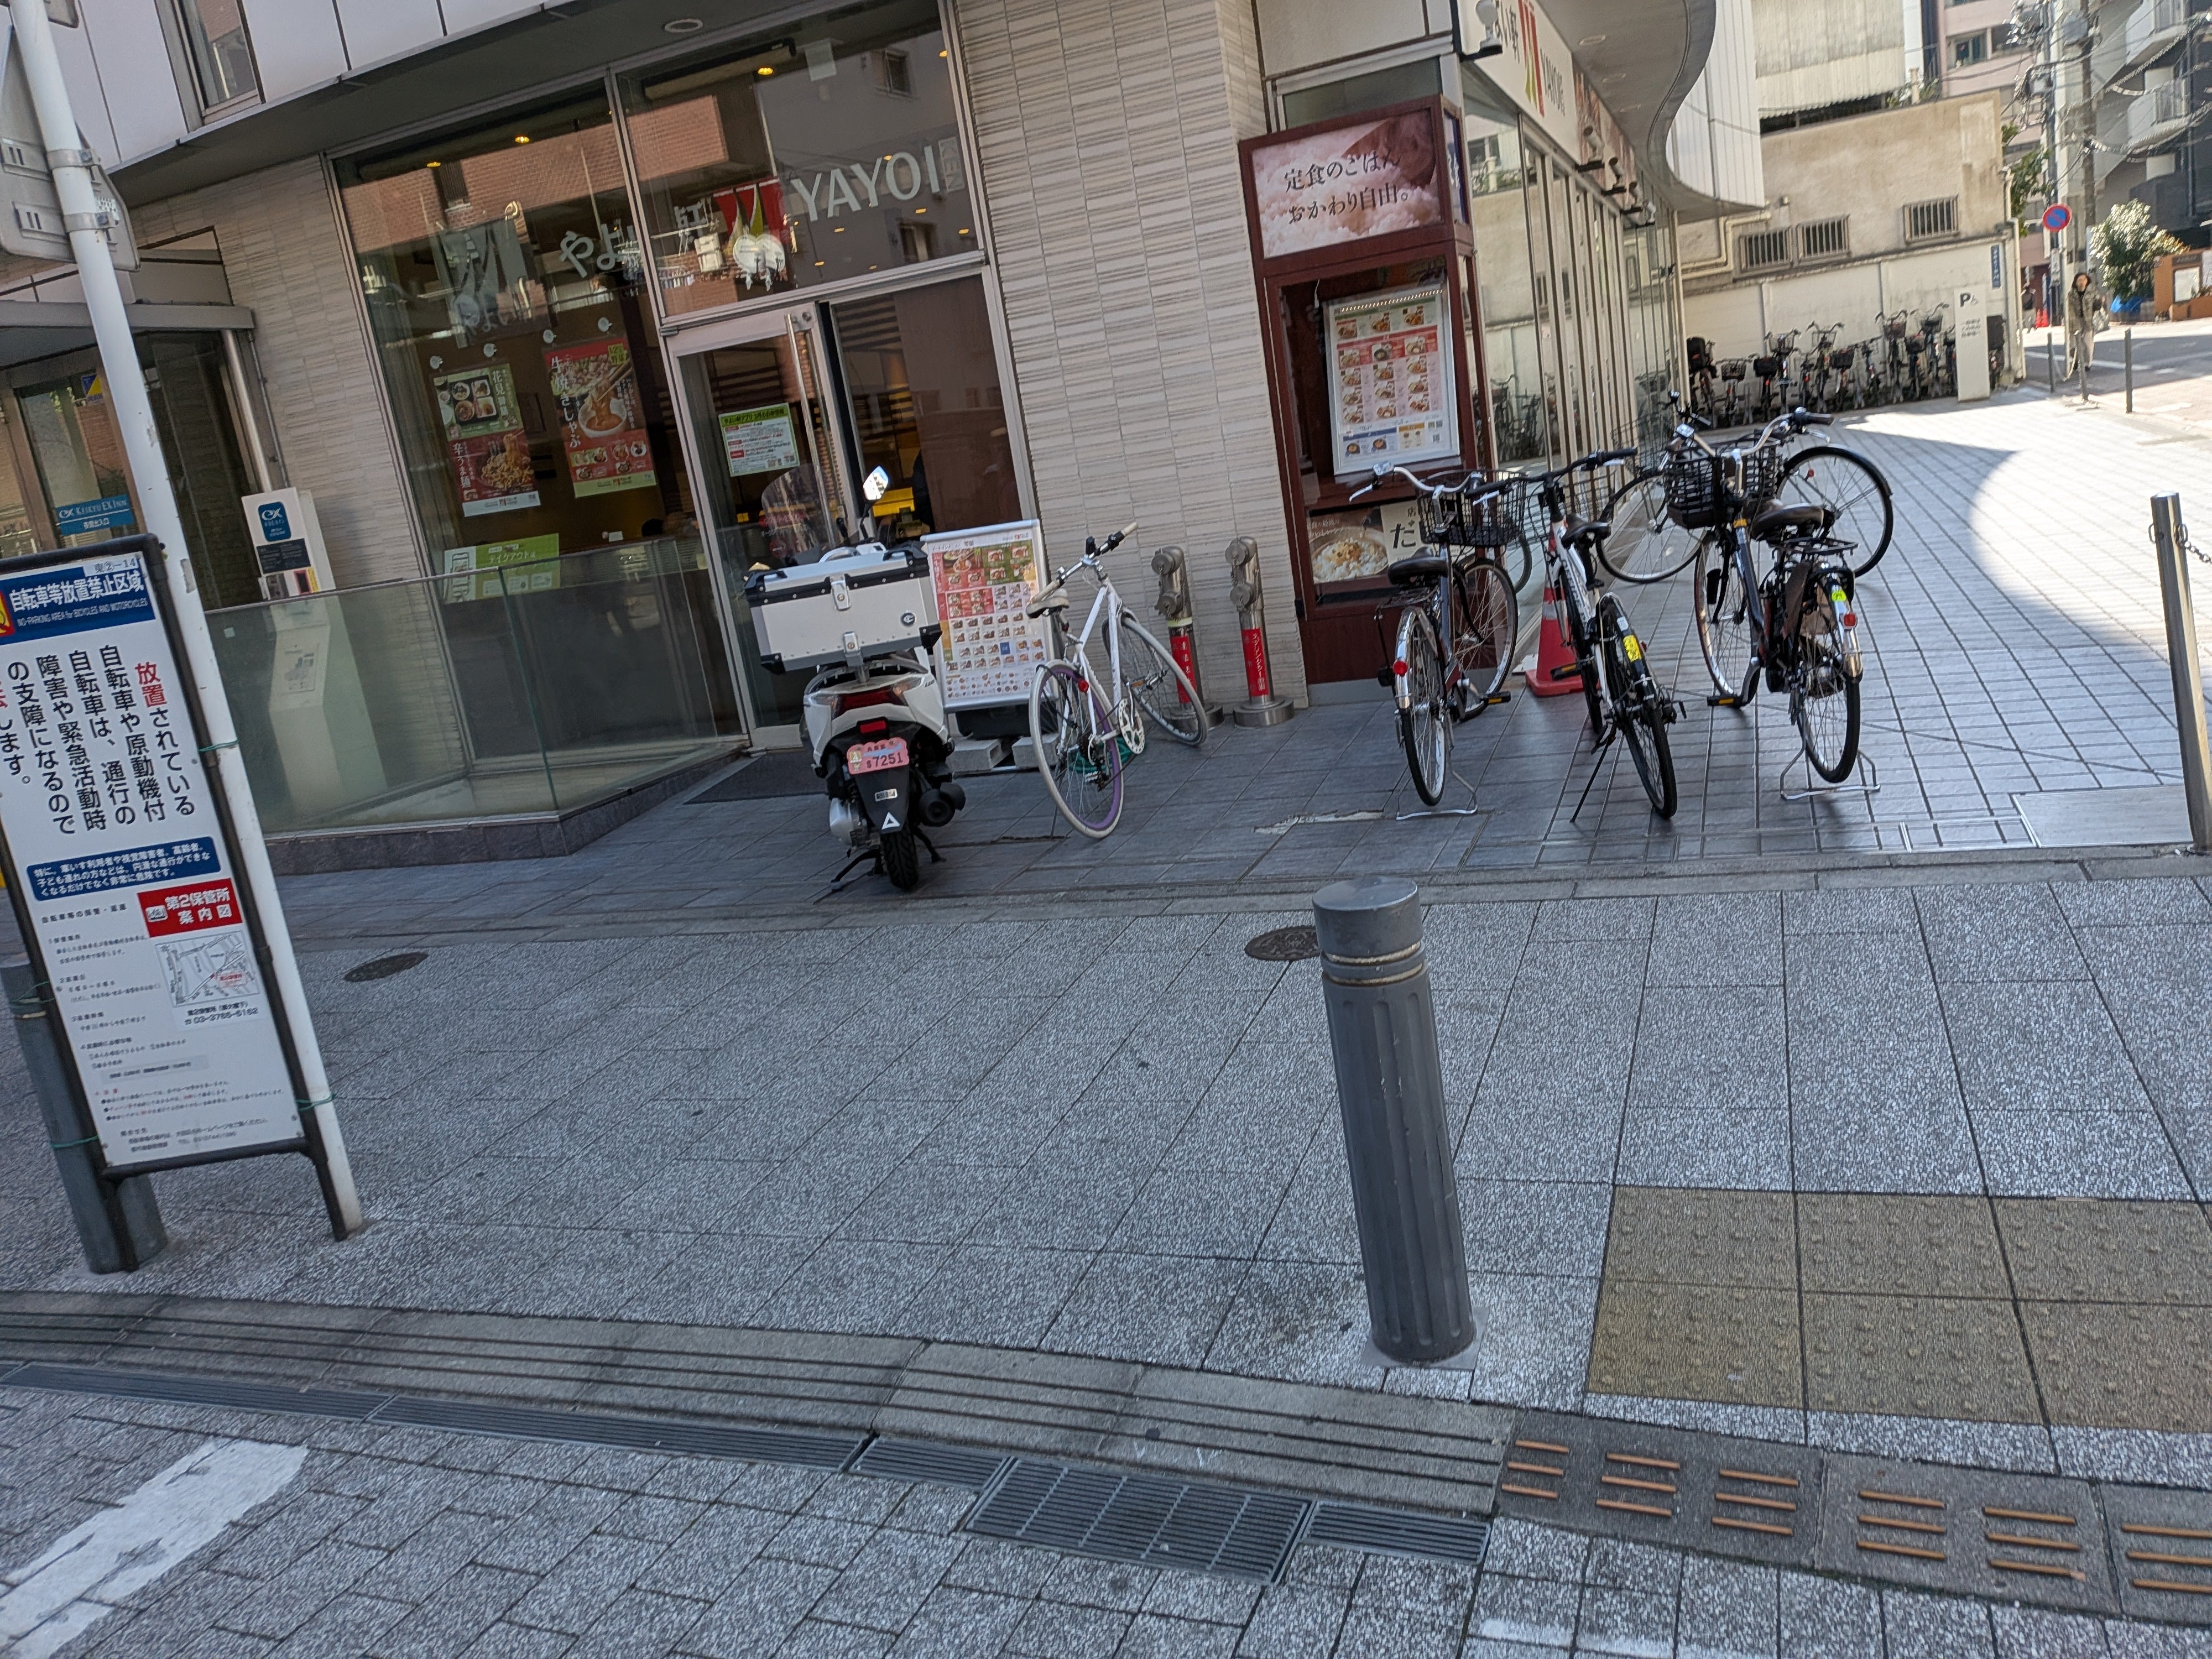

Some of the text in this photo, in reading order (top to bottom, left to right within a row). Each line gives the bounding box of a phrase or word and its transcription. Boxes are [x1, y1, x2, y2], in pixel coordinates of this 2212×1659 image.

[792, 145, 941, 222] YAYOI
[1284, 147, 1402, 194] 定食のごはん
[1288, 183, 1411, 225] おかわり自由。
[1960, 292, 1971, 307] P
[9, 570, 144, 612] 自転車等放置禁止区域
[8, 661, 76, 836] の支障になるので
[36, 654, 107, 831] 障害や緊急活動時
[68, 650, 136, 825] 自転車は、通行の
[100, 644, 166, 822] 自転車や原動機付
[135, 661, 195, 816] 放置されている
[872, 752, 903, 768] 7251
[165, 887, 231, 910] 第2保管所
